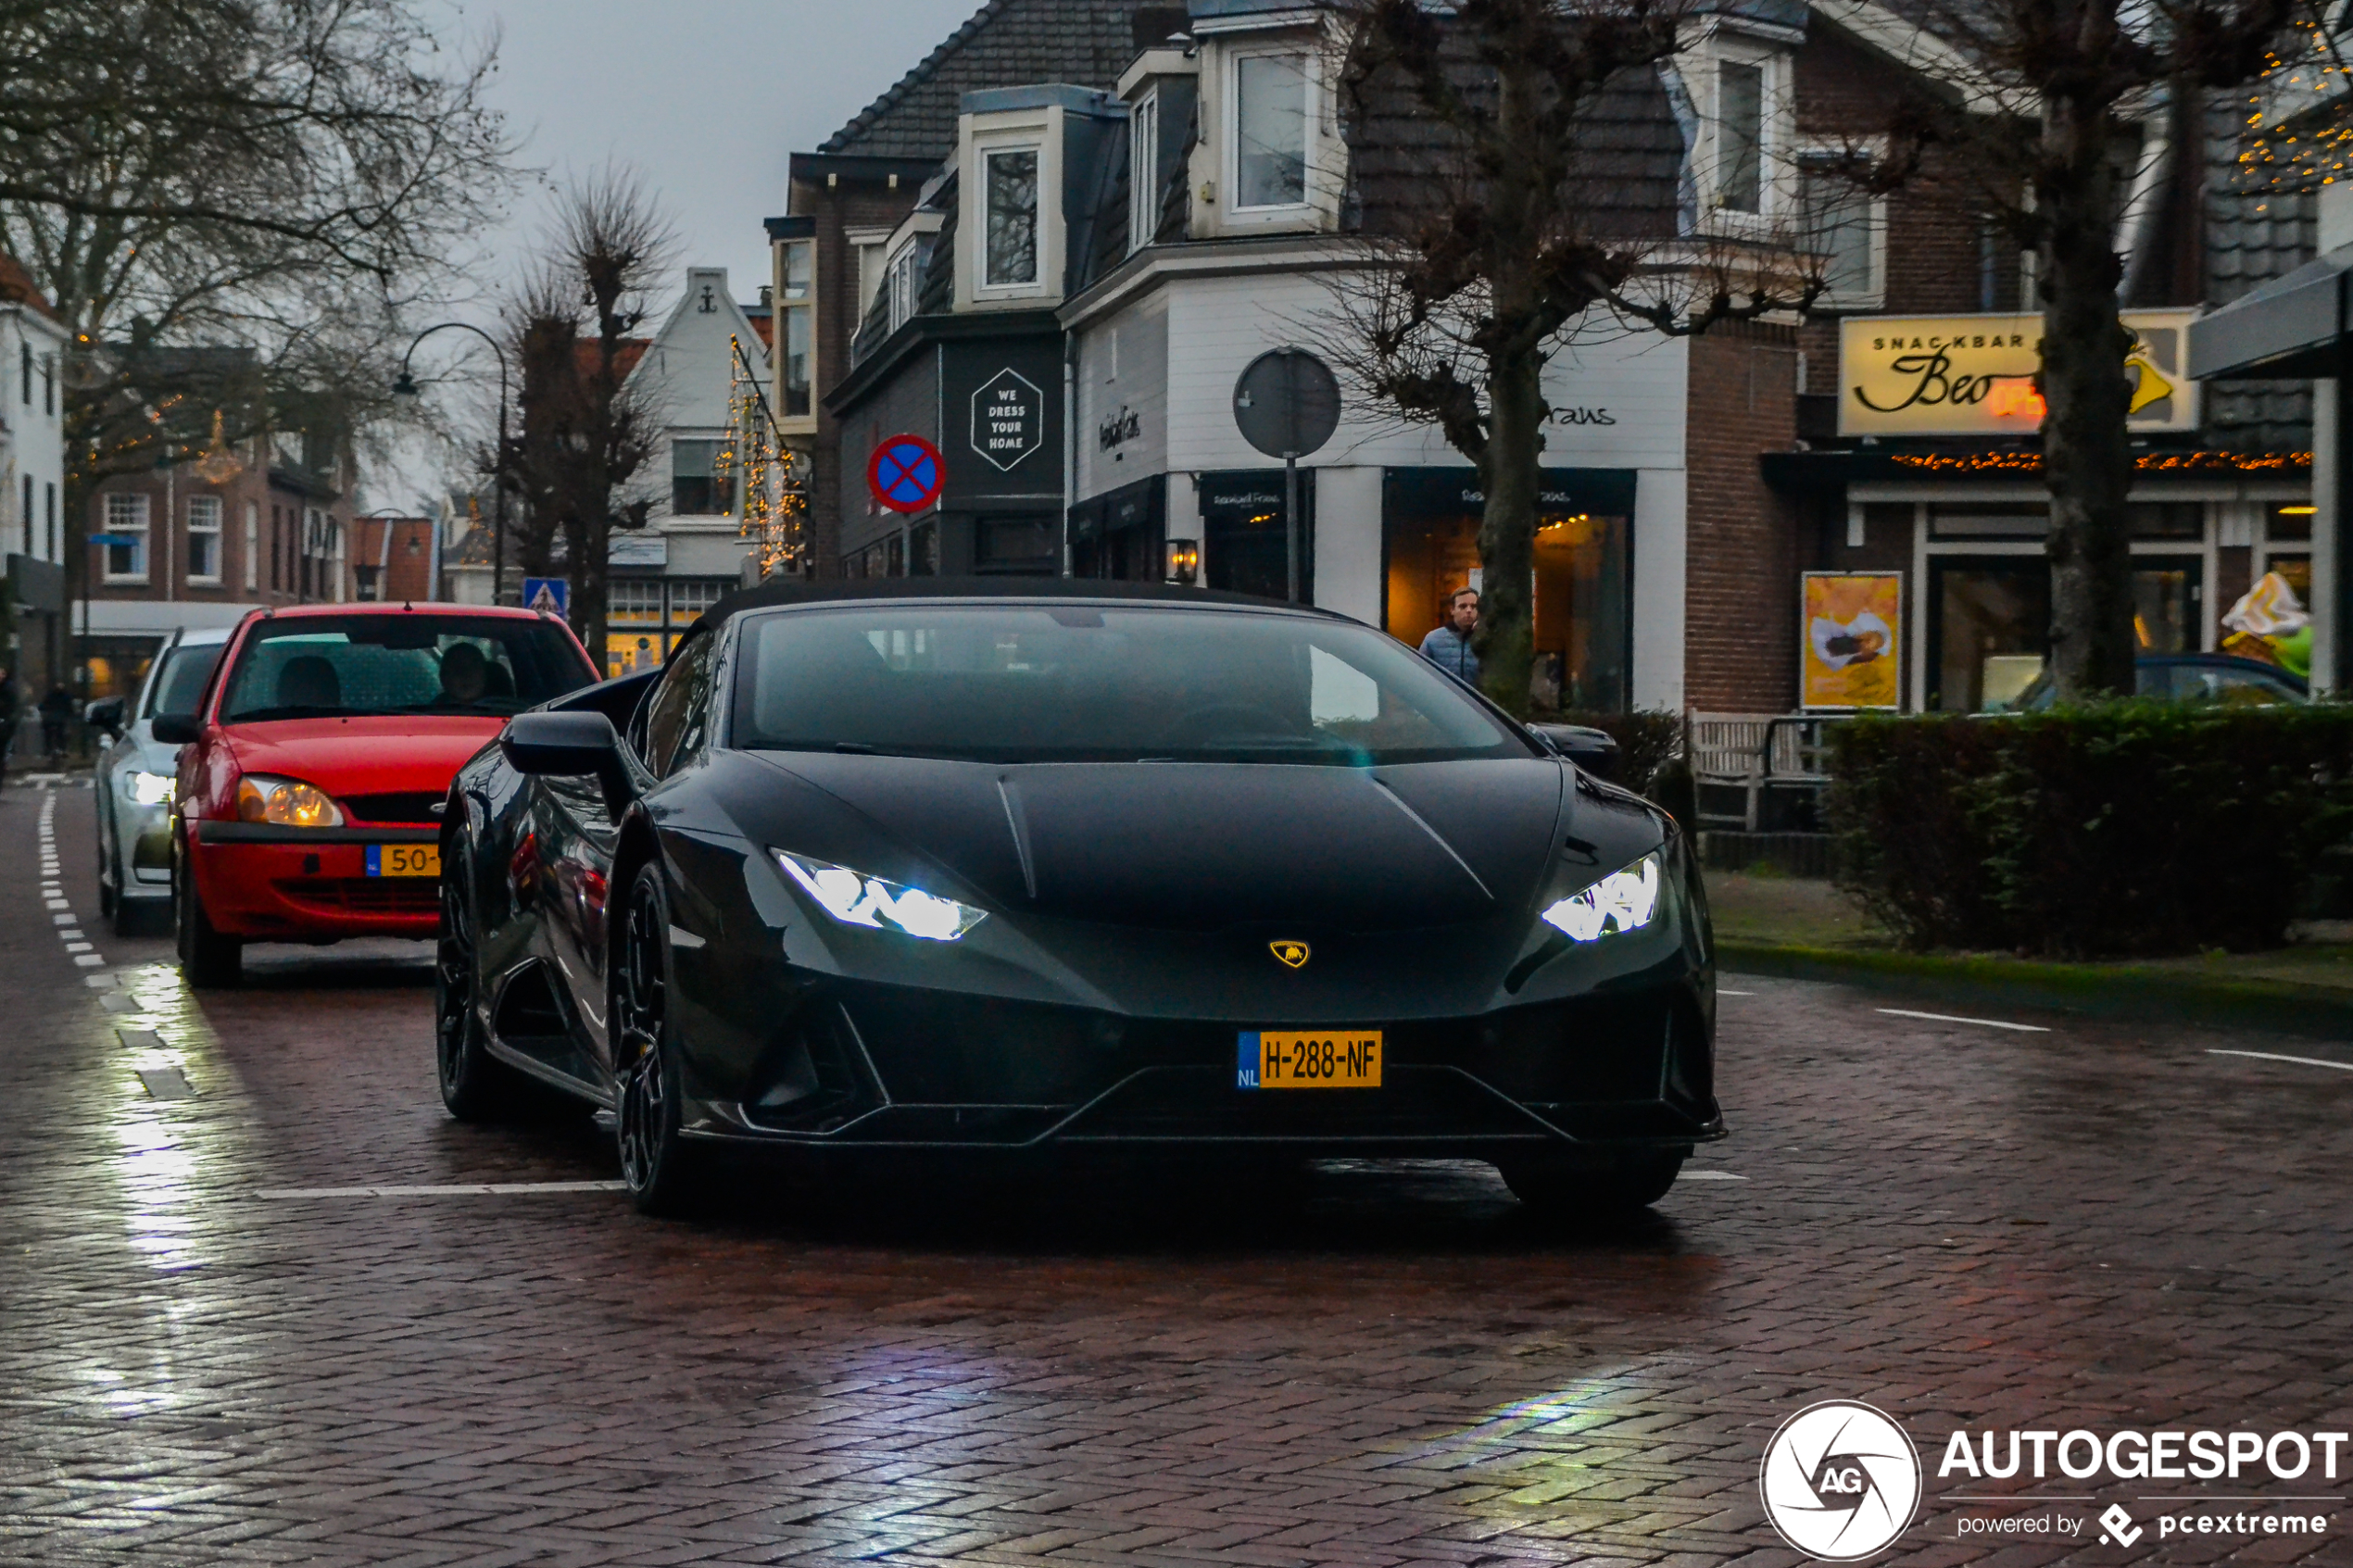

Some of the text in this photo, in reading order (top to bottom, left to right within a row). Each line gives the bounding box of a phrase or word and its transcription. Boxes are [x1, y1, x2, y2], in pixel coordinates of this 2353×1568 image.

[1872, 333, 2024, 351] SNACKBAR
[1853, 343, 2035, 413] Beo
[998, 389, 1017, 401] WE
[1993, 384, 2044, 416] OPE
[988, 406, 1026, 418] DRESS
[1548, 406, 1616, 426] rans
[991, 421, 1022, 433] YOUR
[989, 437, 1023, 449] HOME
[1238, 1040, 1376, 1086] NL H-288-NF
